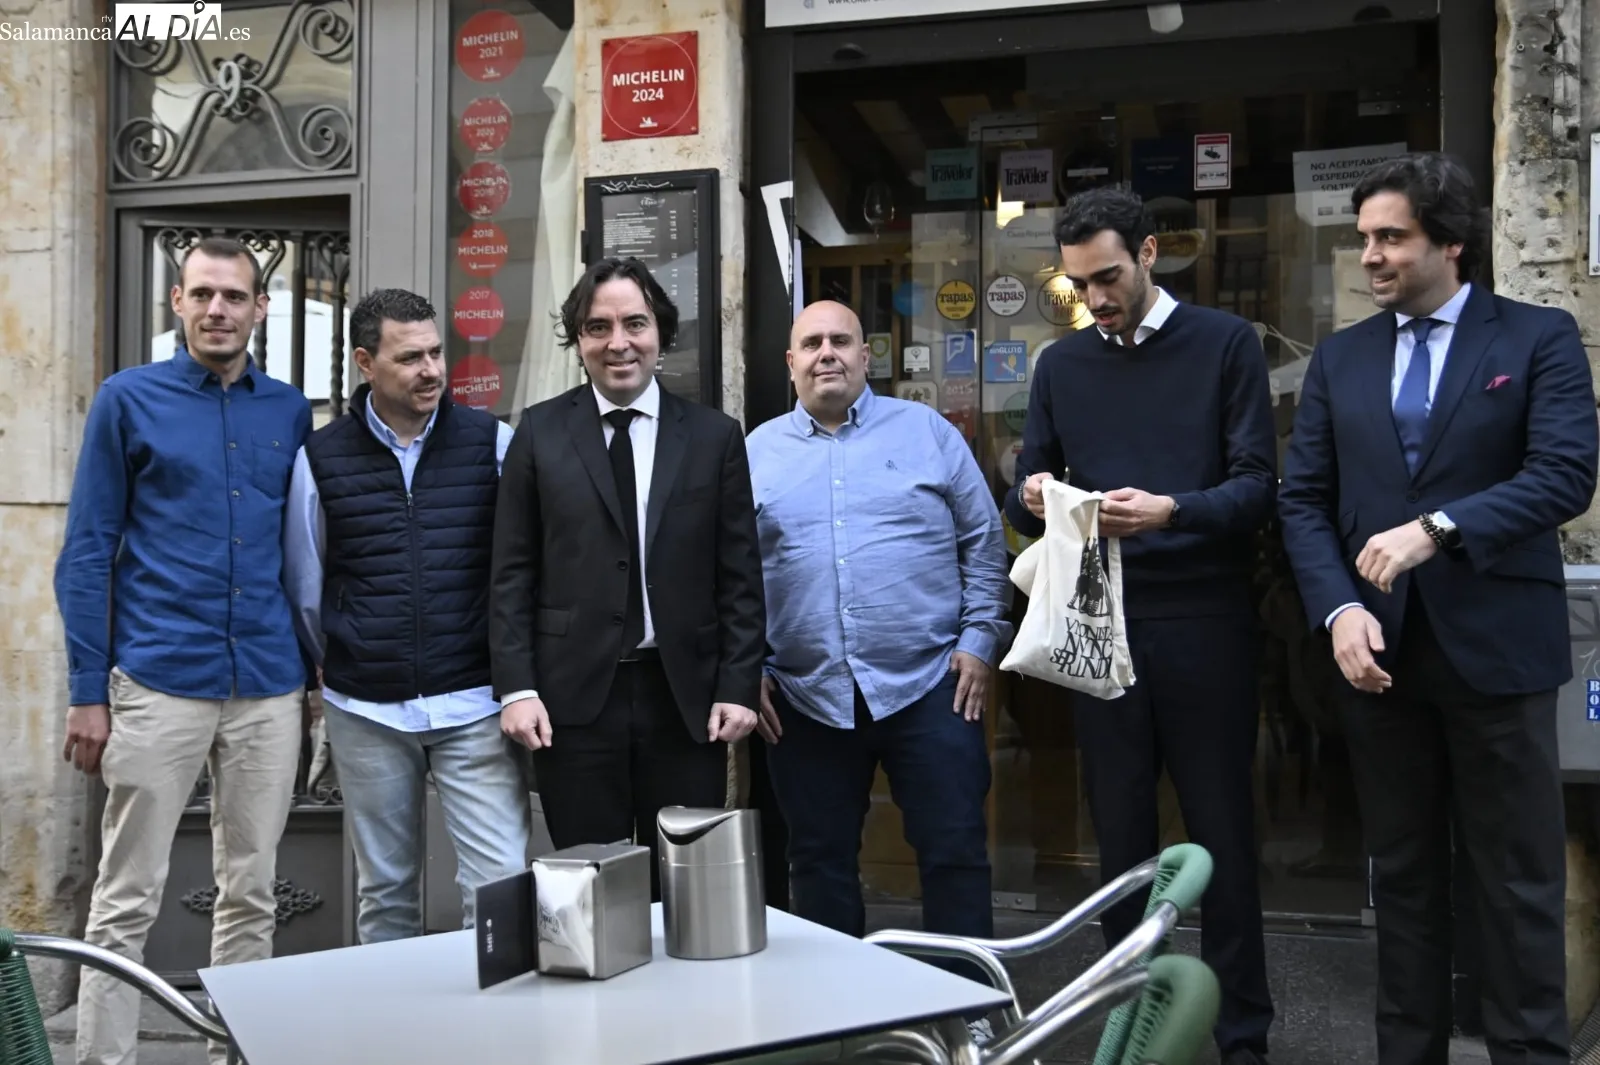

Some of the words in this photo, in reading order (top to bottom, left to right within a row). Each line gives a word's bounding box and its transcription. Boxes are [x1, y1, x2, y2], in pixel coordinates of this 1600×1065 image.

[462, 30, 518, 46] MICHELIN
[479, 47, 504, 59] 2021
[612, 69, 685, 87] MICHELIN
[632, 88, 664, 102] 2024
[464, 115, 507, 126] MICHELIN
[1310, 162, 1326, 171] NO
[931, 164, 974, 183] Traveler
[1004, 167, 1049, 186] Traveler
[1312, 170, 1364, 182] DESPEDID
[462, 177, 507, 187] MICHELIN
[472, 229, 494, 239] 2018
[458, 245, 508, 256] MICHELIN
[469, 291, 490, 300] 2017
[454, 309, 504, 320] MICHELIN
[452, 382, 500, 396] MICHELIN
